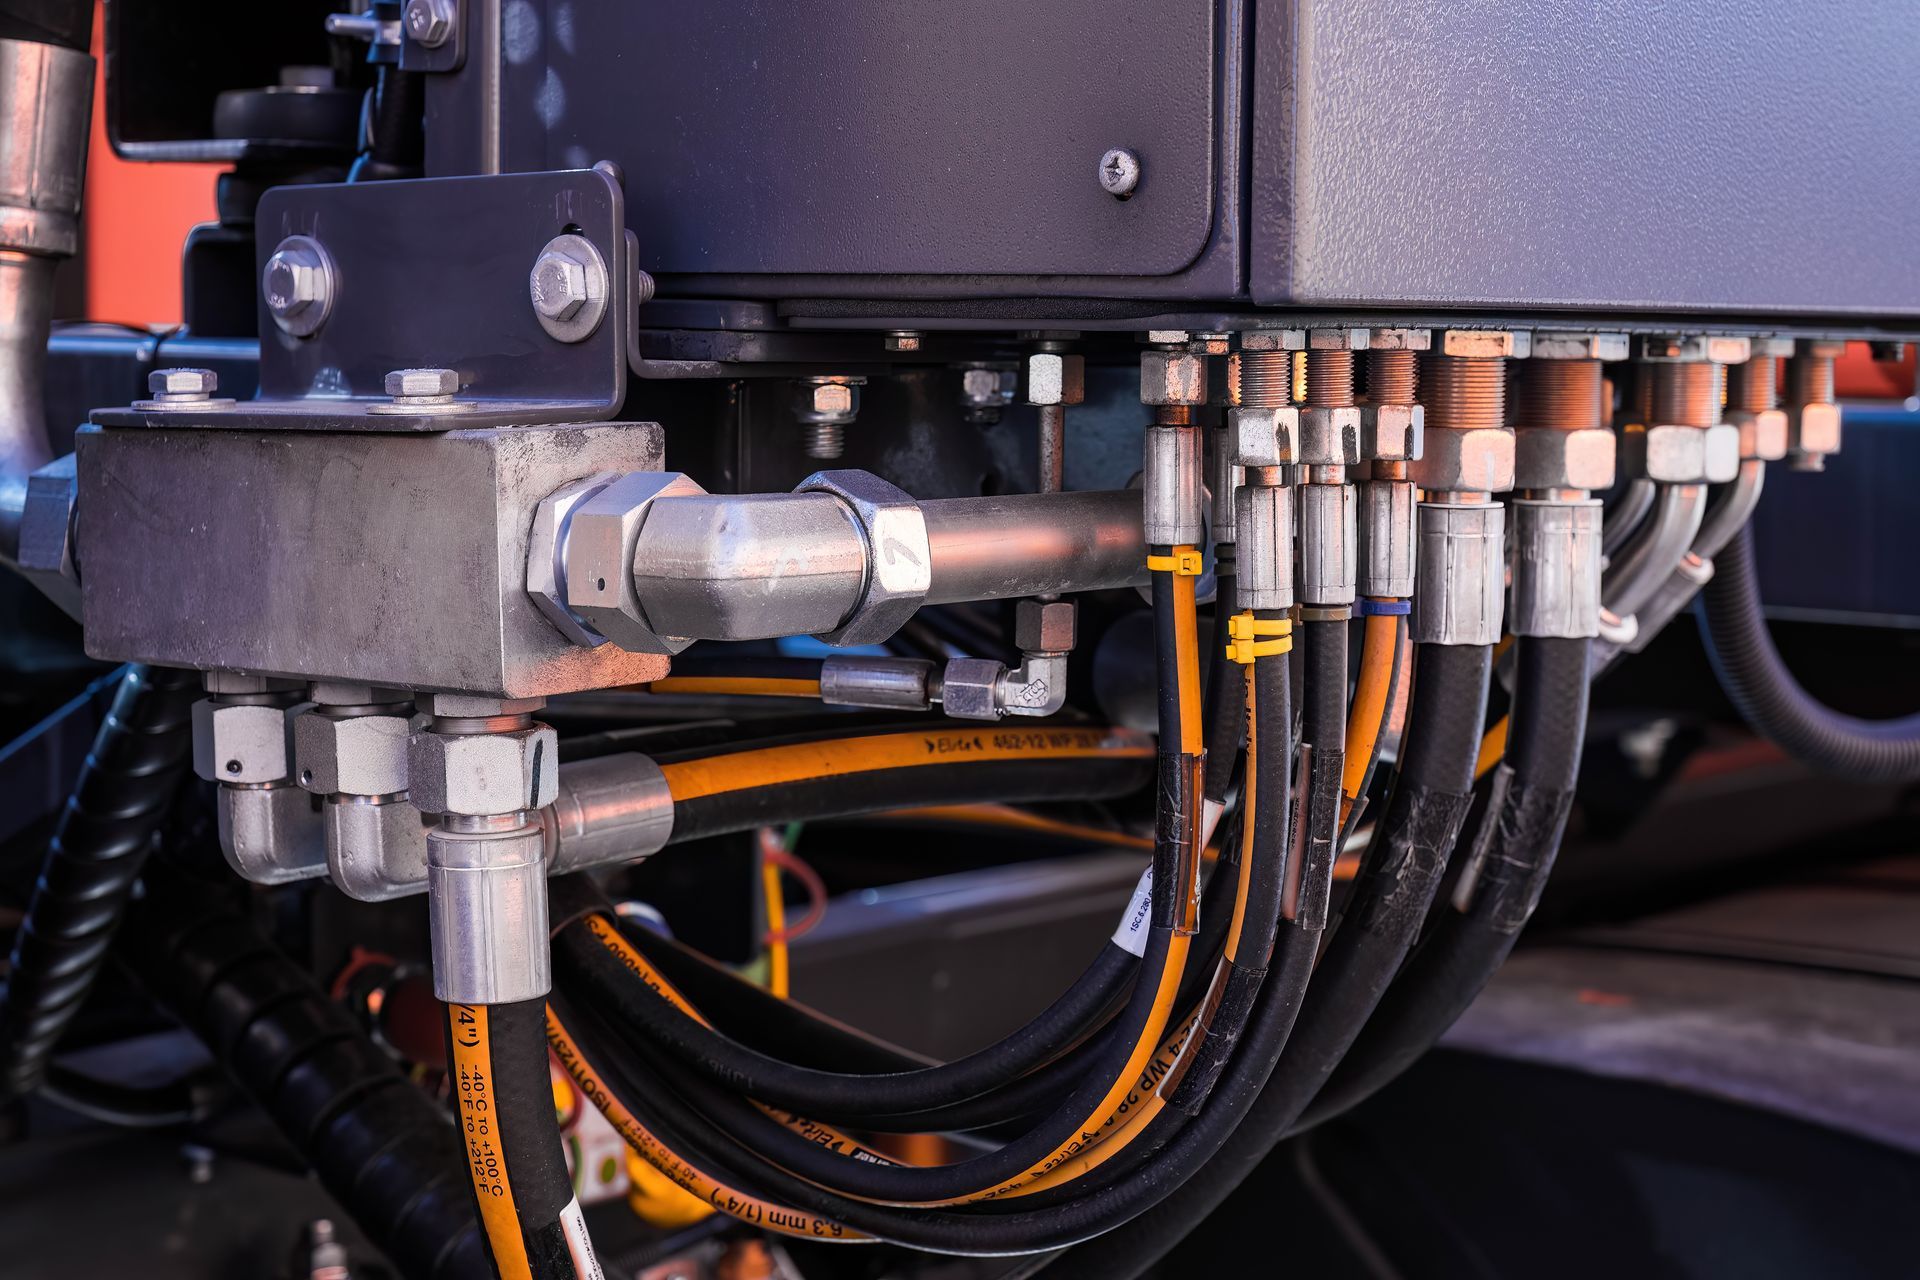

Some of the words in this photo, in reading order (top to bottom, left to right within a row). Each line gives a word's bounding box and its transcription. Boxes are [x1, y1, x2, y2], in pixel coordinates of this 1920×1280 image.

[472, 1064, 488, 1111] -40°C
[1140, 1058, 1171, 1091] WP
[465, 1116, 475, 1133] TO
[478, 1117, 489, 1135] TO
[482, 1140, 504, 1197] +100°C
[769, 1211, 806, 1230] mm
